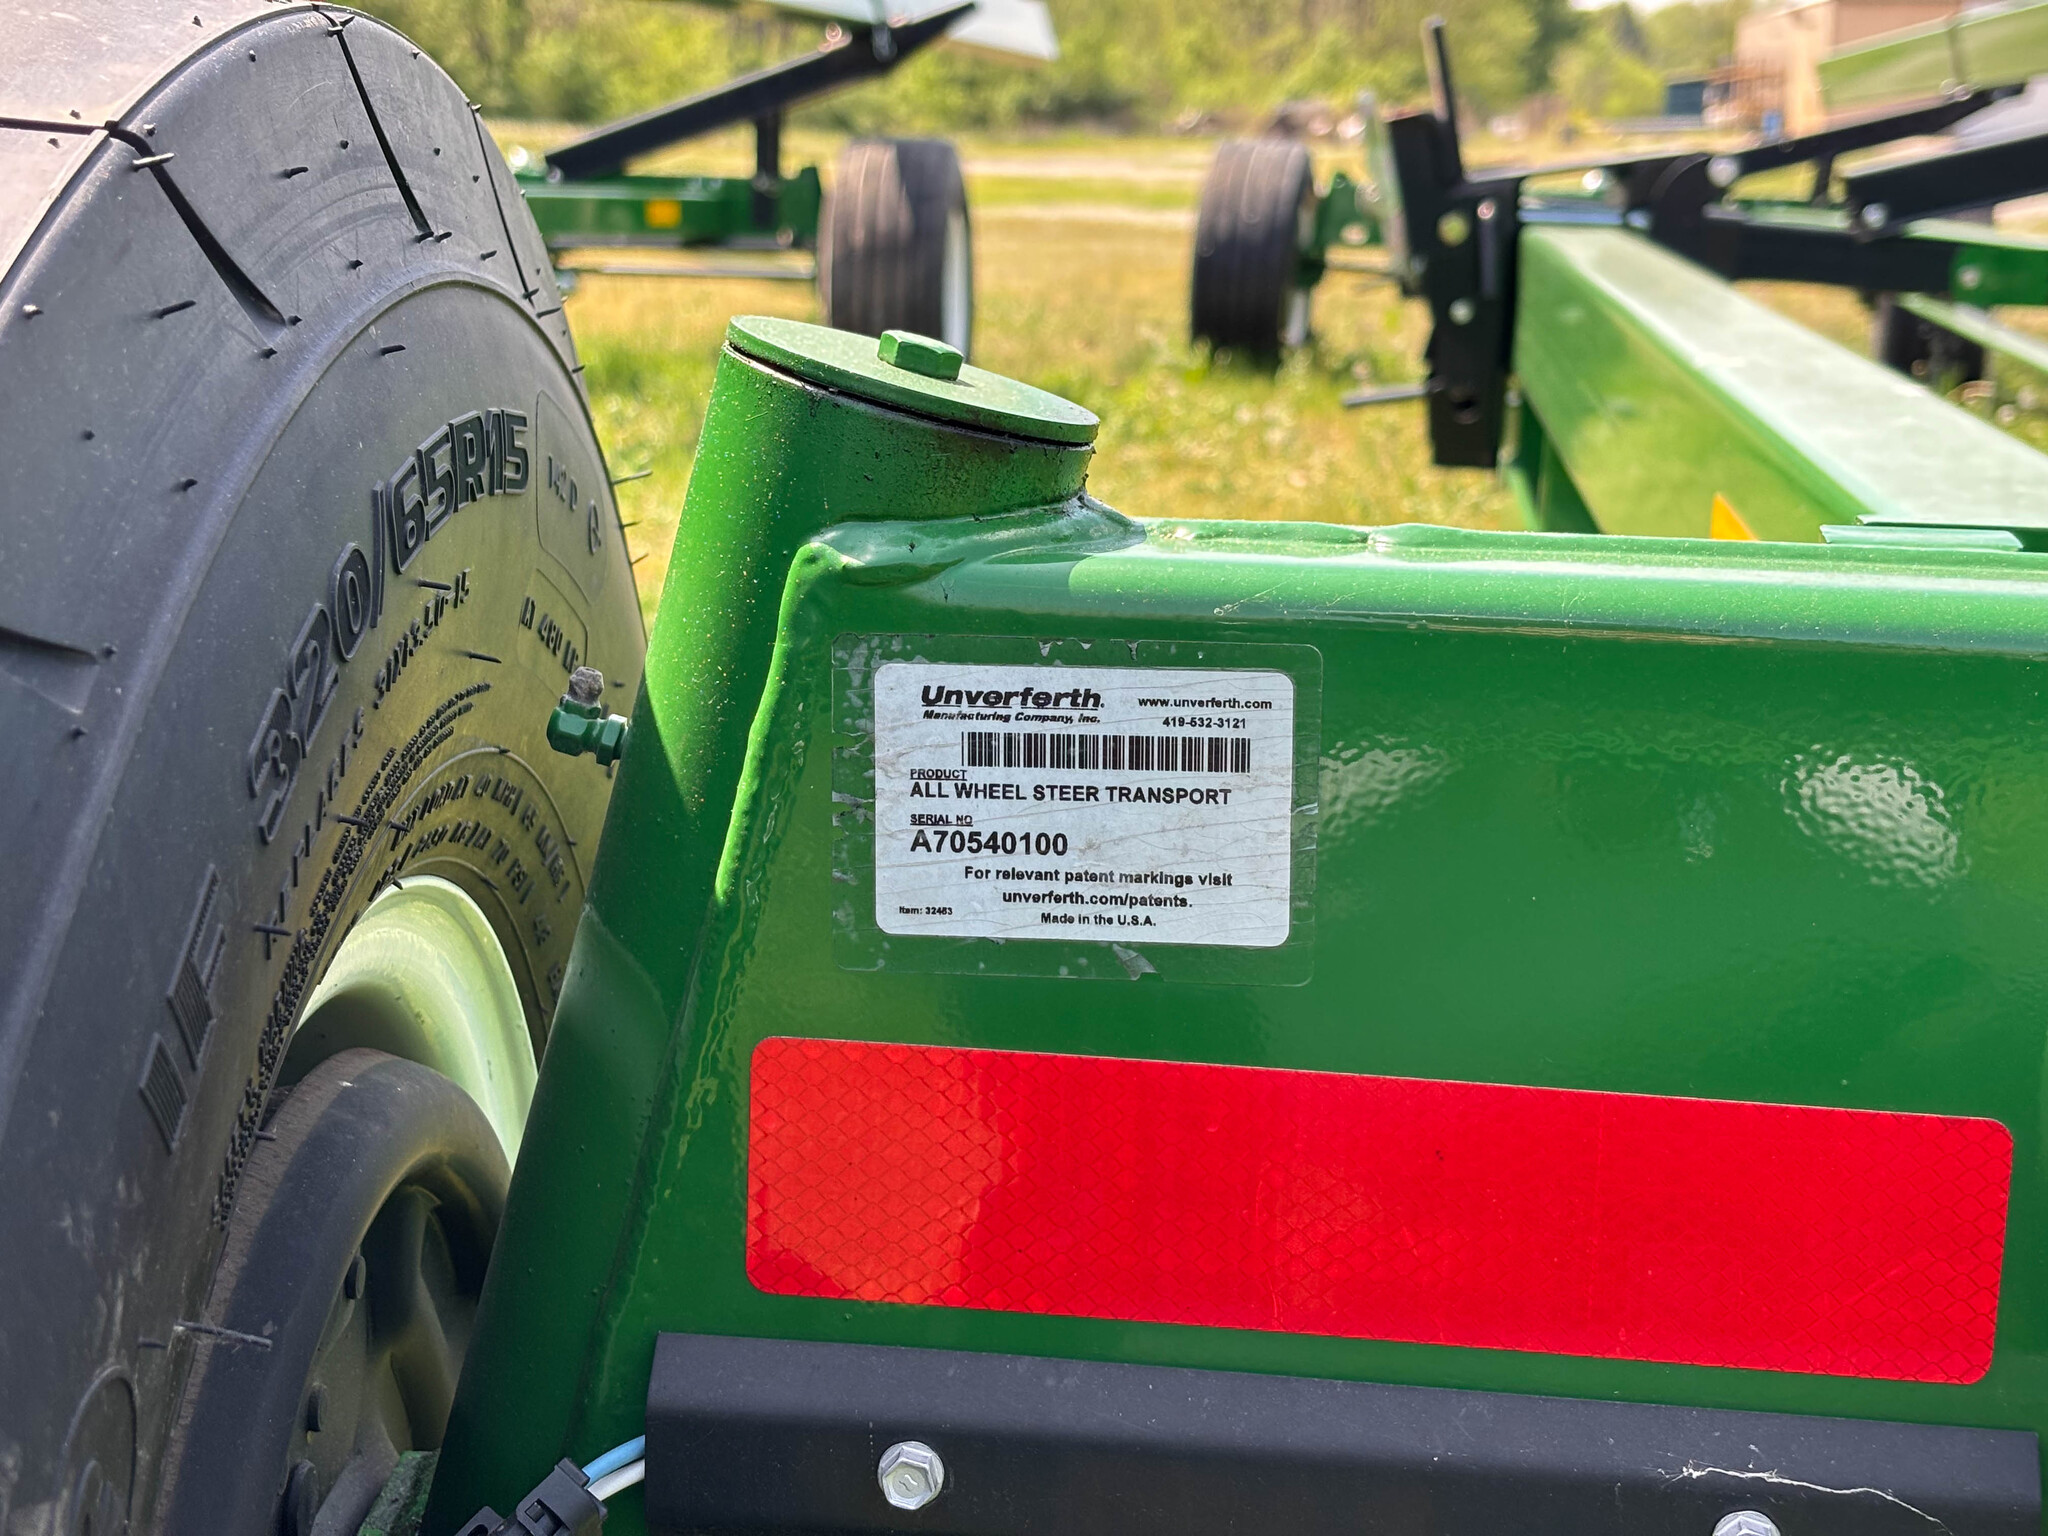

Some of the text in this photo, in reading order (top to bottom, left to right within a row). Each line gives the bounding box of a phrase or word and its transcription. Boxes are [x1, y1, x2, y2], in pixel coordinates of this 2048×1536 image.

[248, 407, 529, 845] 320/65R15
[1138, 697, 1272, 709] www.unverferth.com
[923, 710, 1100, 724] Manufacturing Company, Inc.
[1163, 717, 1245, 728] 419-532-3121
[910, 769, 967, 780] PRODUCT
[910, 782, 1232, 804] ALL WHEEL STEER TRANSPORT
[910, 814, 973, 827] SERIAL NO
[910, 830, 1068, 856] A70540100
[965, 866, 1232, 887] For relevant patent markings visit
[1003, 891, 1192, 908] unverferth.com/patents.
[1041, 913, 1156, 926] Made in the U.S.A.
